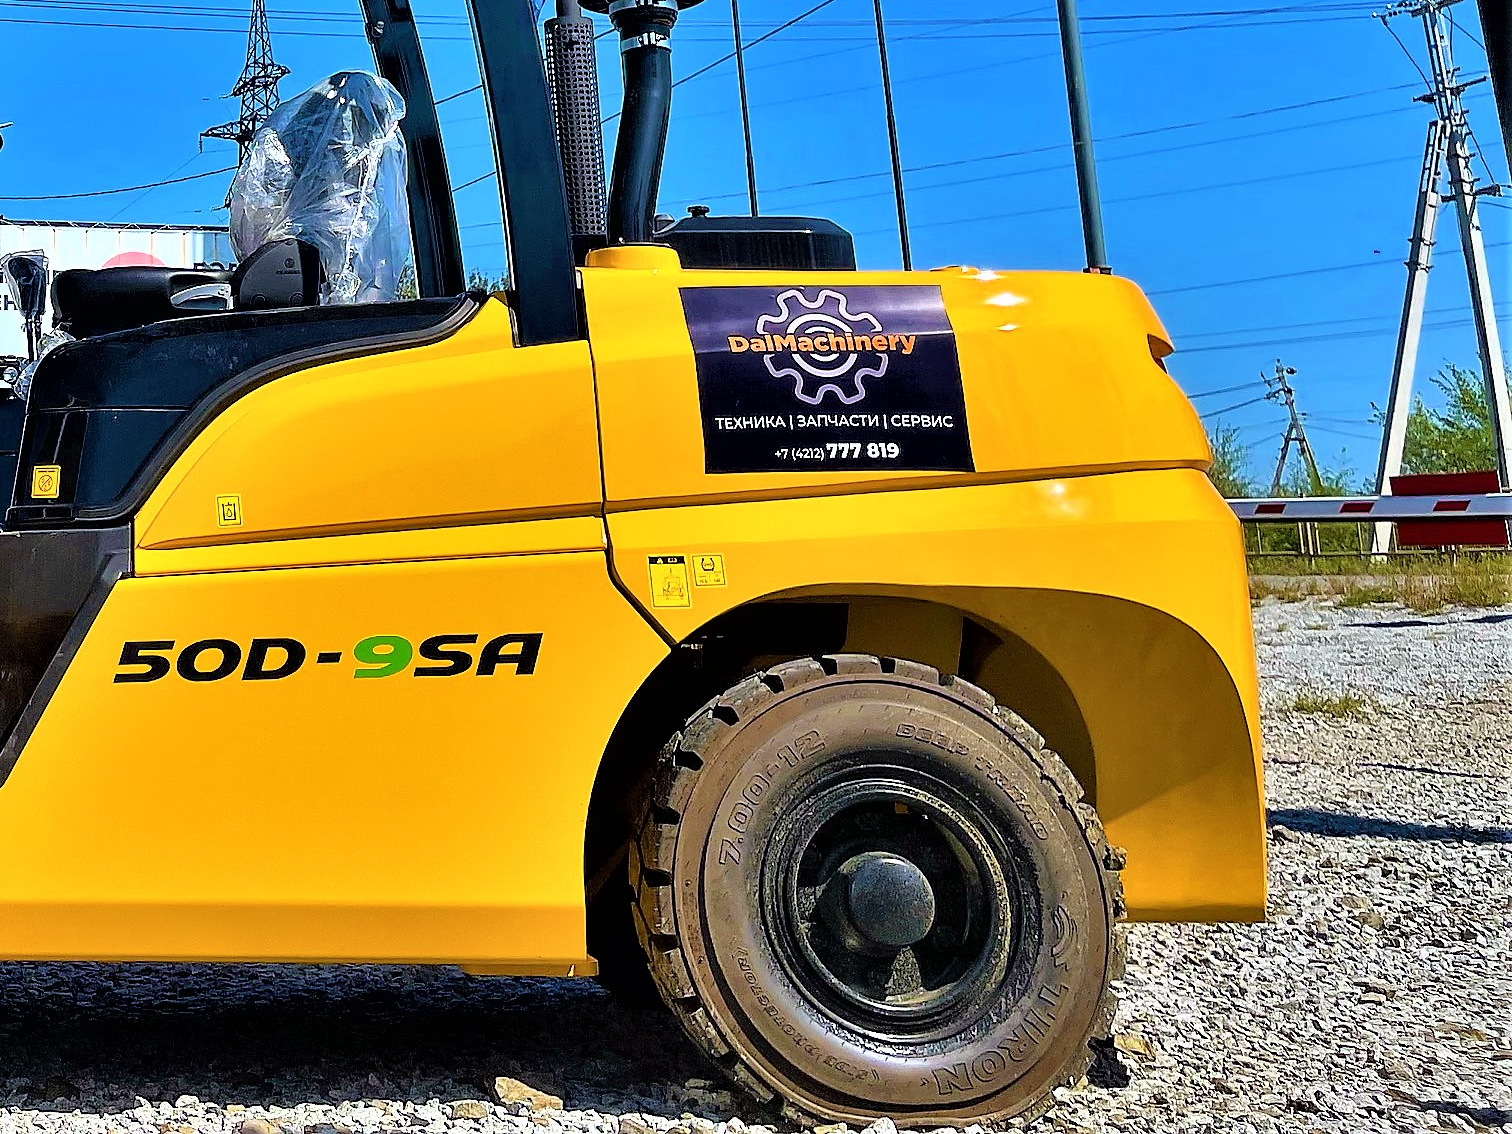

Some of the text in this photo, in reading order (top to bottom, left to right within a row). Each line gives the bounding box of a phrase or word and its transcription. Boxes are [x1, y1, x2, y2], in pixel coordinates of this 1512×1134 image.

[728, 331, 916, 355] DalMachinery
[715, 414, 954, 430] ТЕХНИКА ЗАПЧАСТИ СЕРВИС
[774, 442, 899, 461] +7 (4212) 777 819
[113, 632, 544, 684] 50D-9SA
[718, 730, 826, 866] 7.00-12
[931, 982, 1069, 1096] TIRON
